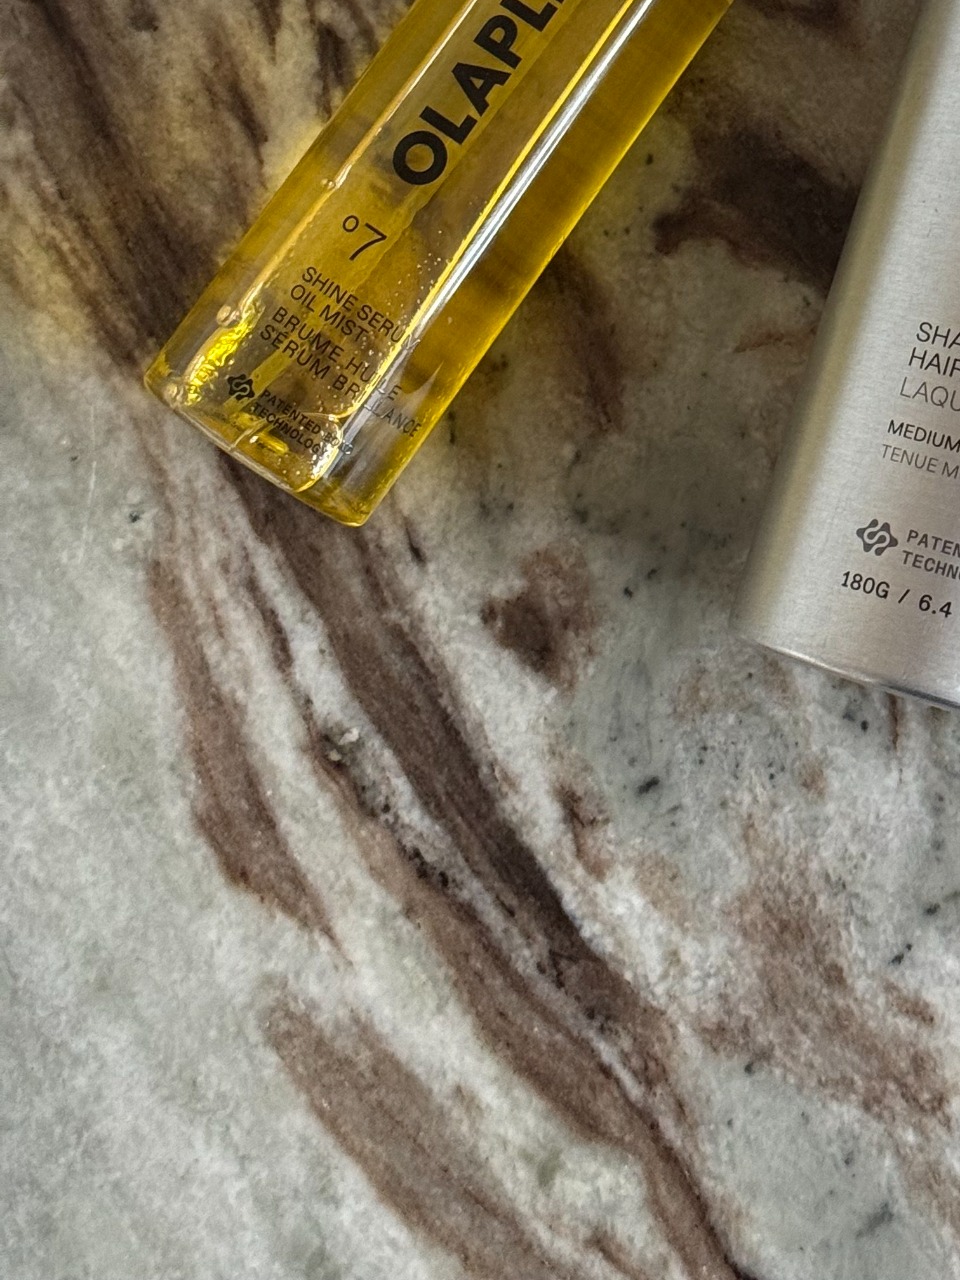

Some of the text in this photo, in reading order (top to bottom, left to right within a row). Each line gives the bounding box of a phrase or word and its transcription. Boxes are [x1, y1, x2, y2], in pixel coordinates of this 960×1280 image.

[302, 266, 359, 312] SHINE
[272, 306, 345, 363] BRUME
[290, 284, 369, 342] OIL MIST
[260, 324, 331, 380] SÉRUM
[260, 389, 321, 435] PATENTED
[882, 444, 939, 473] TENUE
[841, 571, 890, 599] 180G
[918, 594, 952, 618] 6.4
